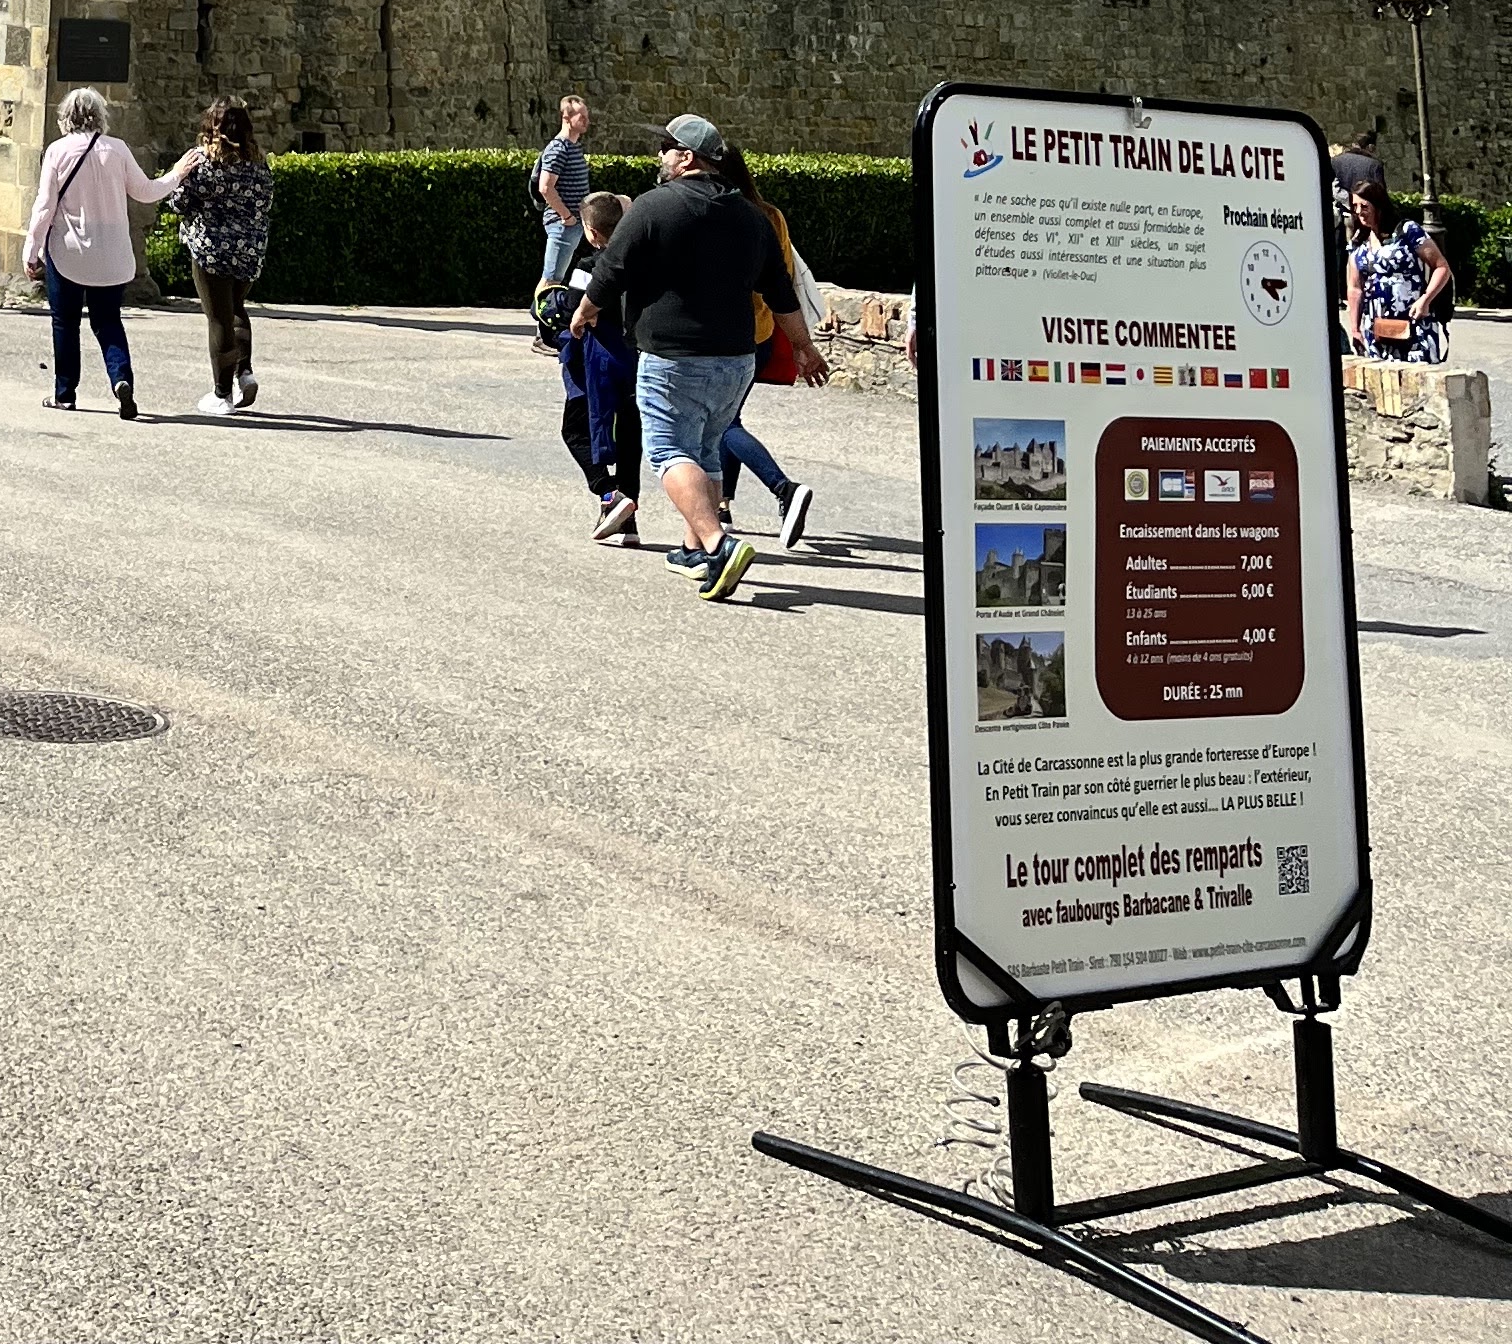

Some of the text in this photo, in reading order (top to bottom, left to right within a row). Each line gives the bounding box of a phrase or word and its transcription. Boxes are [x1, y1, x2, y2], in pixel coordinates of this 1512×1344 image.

[1011, 126, 1285, 181] LE PETIT TRAIN DE LA CITE
[983, 192, 1204, 220] Je ne sache pas qu'il existe nulle part, en Europe,
[974, 212, 1205, 236] un ensemble aussi complet et aussi formidable de
[1223, 204, 1304, 234] Prochain départ
[974, 227, 1016, 242] défenses
[1022, 230, 1038, 242] des
[1090, 236, 1100, 246] et
[1130, 237, 1161, 252] siècles,
[1167, 242, 1179, 251] un
[1185, 241, 1206, 255] sujet
[975, 244, 1207, 272] d'études aussi intéressantes et une situation plus
[1253, 253, 1260, 261] 11
[1261, 248, 1269, 258] 12
[975, 263, 1029, 280] pittoresque
[1042, 316, 1236, 351] VISITE COMMENTEE
[1141, 434, 1256, 453] PAIEMENTS ACCEPTÉS
[1249, 478, 1275, 491] pass
[1119, 523, 1280, 542] Encaissement dans les wagons
[1125, 555, 1273, 572] Adultes 7,00 €
[1126, 581, 1274, 600] Étudiants 6,00 €
[1143, 608, 1153, 619] 25
[1126, 628, 1276, 646] Enfants 4,00 €
[1140, 653, 1149, 664] 12
[1163, 682, 1201, 701] DURÉE
[1209, 684, 1223, 699] 25
[1225, 686, 1243, 699] mn
[977, 761, 989, 776] La
[993, 758, 1015, 774] Cité
[1017, 758, 1032, 773] de
[1034, 756, 1105, 772] Carcassonne
[1107, 754, 1124, 768] est
[1126, 751, 1137, 766] la
[1139, 750, 1162, 769] plus
[1165, 748, 1203, 768] grande
[1206, 747, 1259, 762] forteresse
[1262, 744, 1310, 760] d'Europe
[985, 768, 1312, 801] En Petit Train par son côté guerrier le plus beau l'extérieur,
[994, 792, 1297, 827] vous serez convaincus qu'elle est aussi... LA PLUS BELLE
[1006, 836, 1263, 888] Le tour complet des remparts
[1022, 884, 1253, 928] avec faubourgs Barbacane & Trivalle
